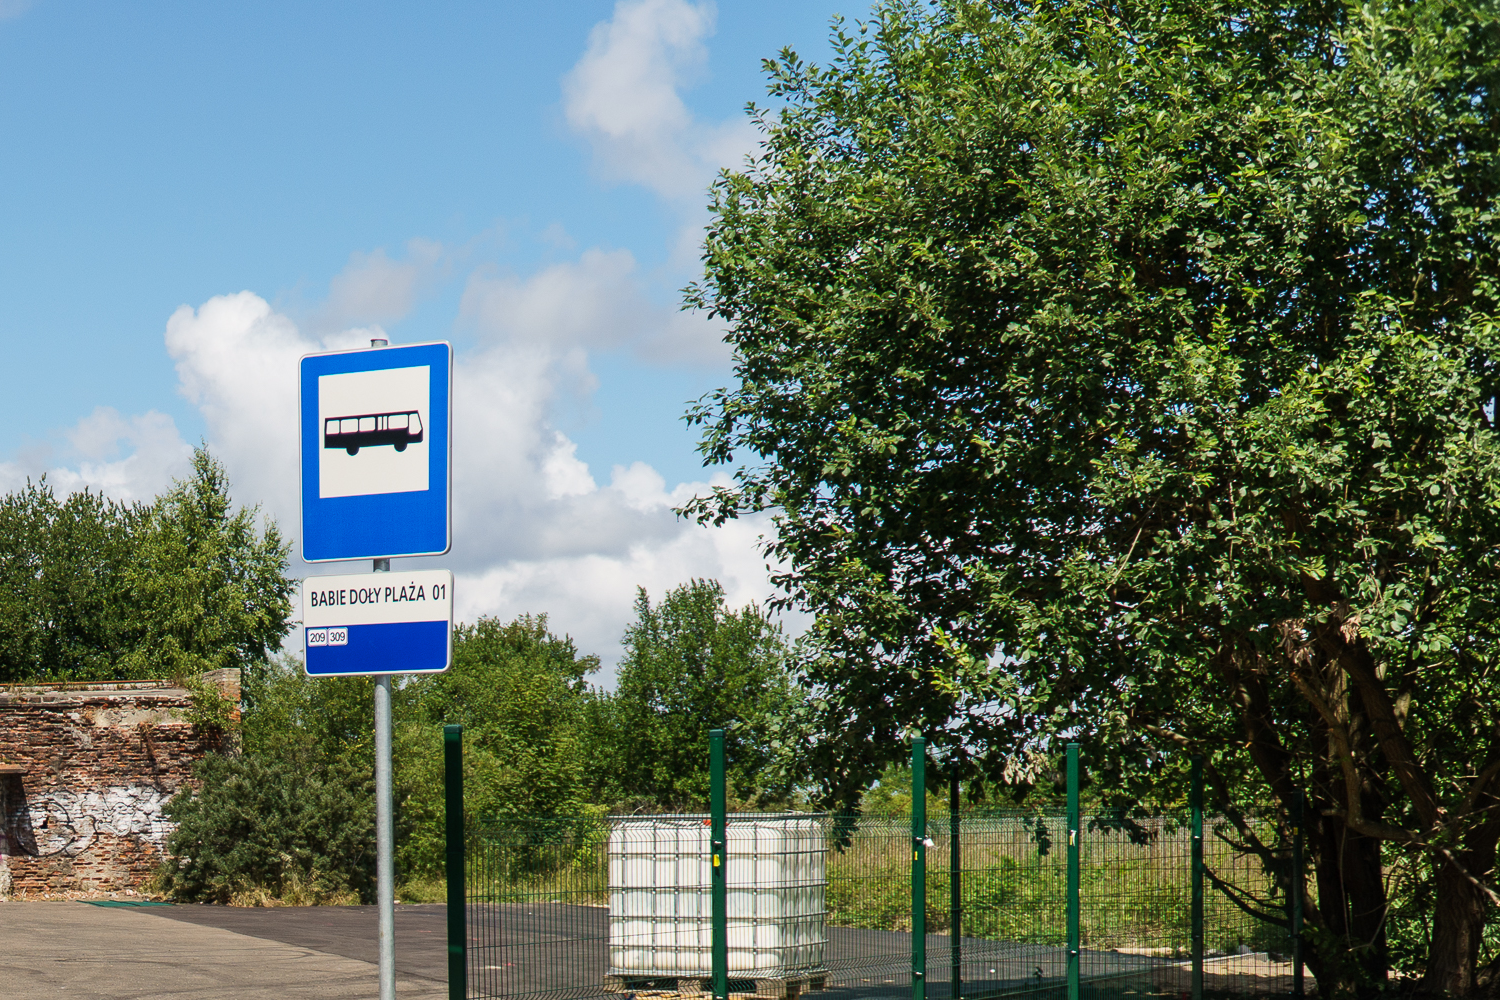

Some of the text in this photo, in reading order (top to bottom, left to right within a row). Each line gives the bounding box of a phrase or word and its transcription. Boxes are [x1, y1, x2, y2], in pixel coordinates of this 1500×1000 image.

[311, 581, 446, 607] BABIE DOŁY PLAŻA 01
[309, 631, 346, 643] 209 309
